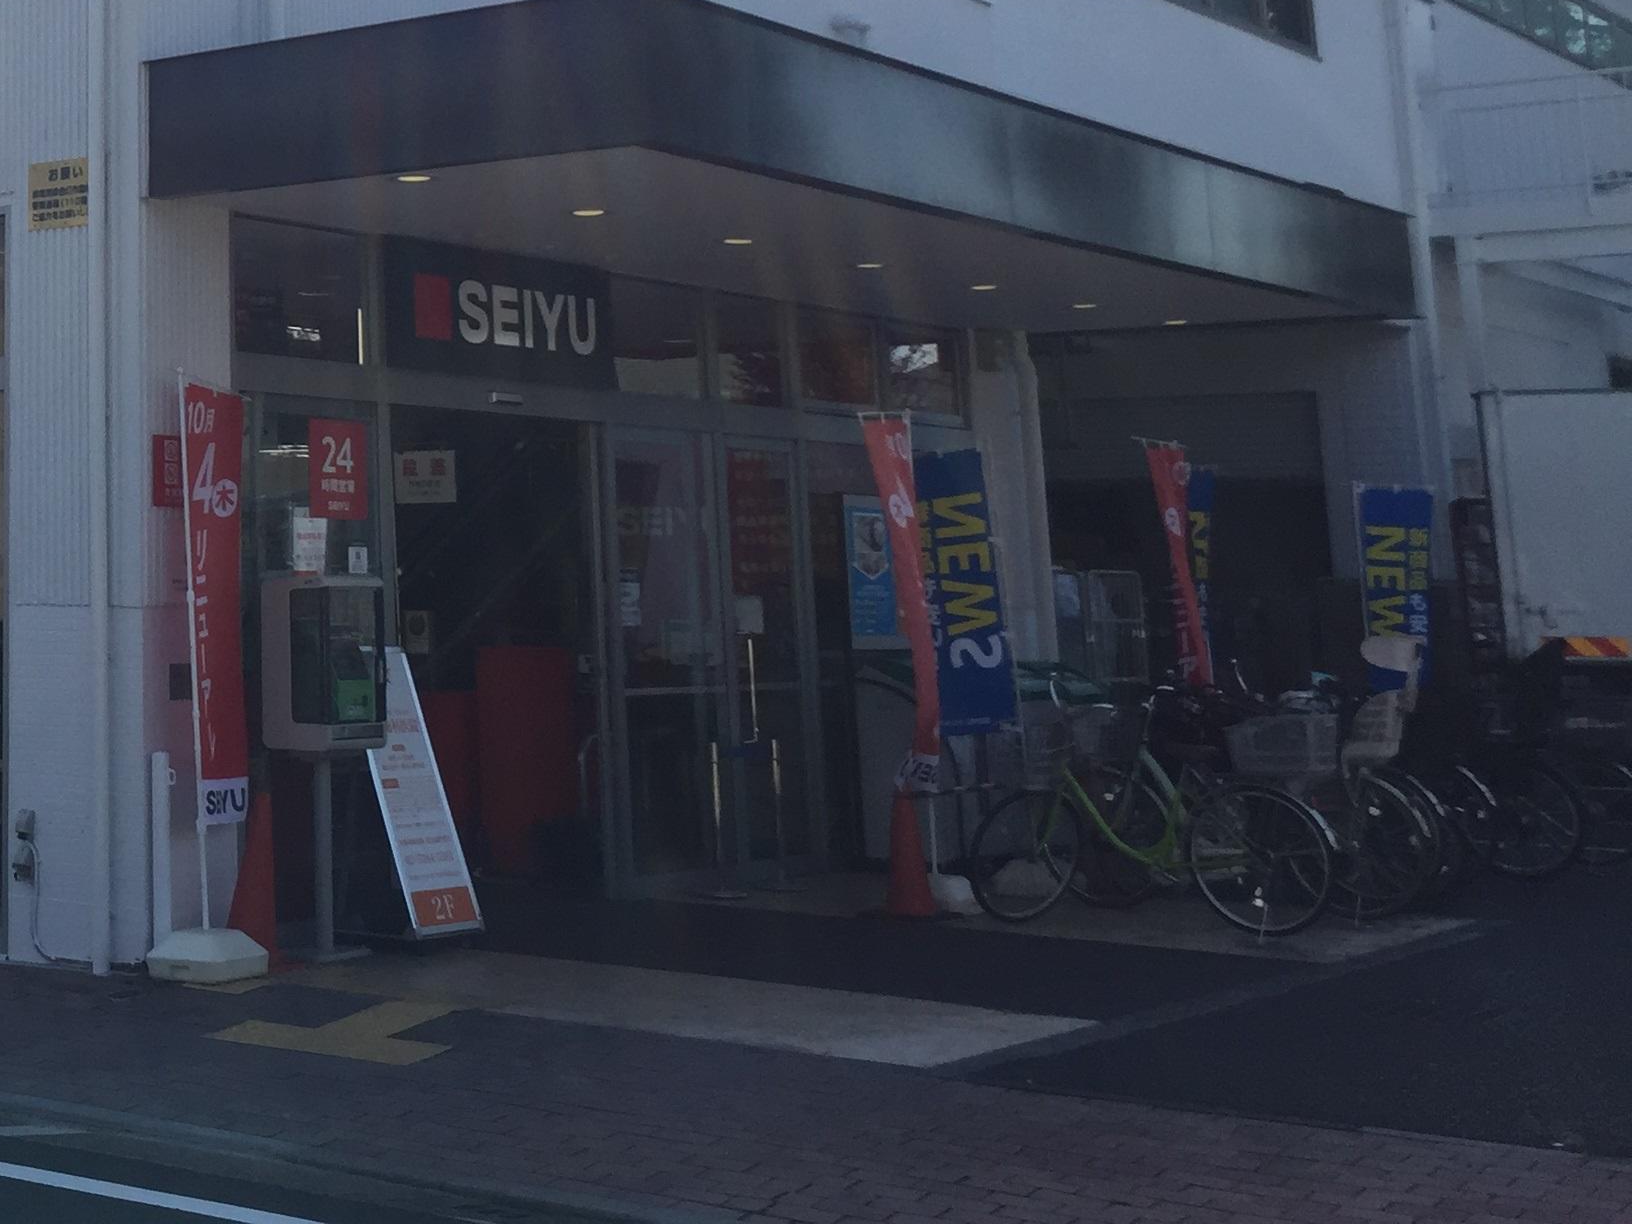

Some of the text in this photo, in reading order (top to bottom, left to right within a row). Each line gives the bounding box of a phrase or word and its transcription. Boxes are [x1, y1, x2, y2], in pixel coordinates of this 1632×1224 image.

[458, 280, 596, 355] SEIYU
[188, 401, 215, 434] 10月
[321, 435, 355, 474] 24
[1366, 526, 1406, 638] NEW
[431, 894, 455, 920] 2F
